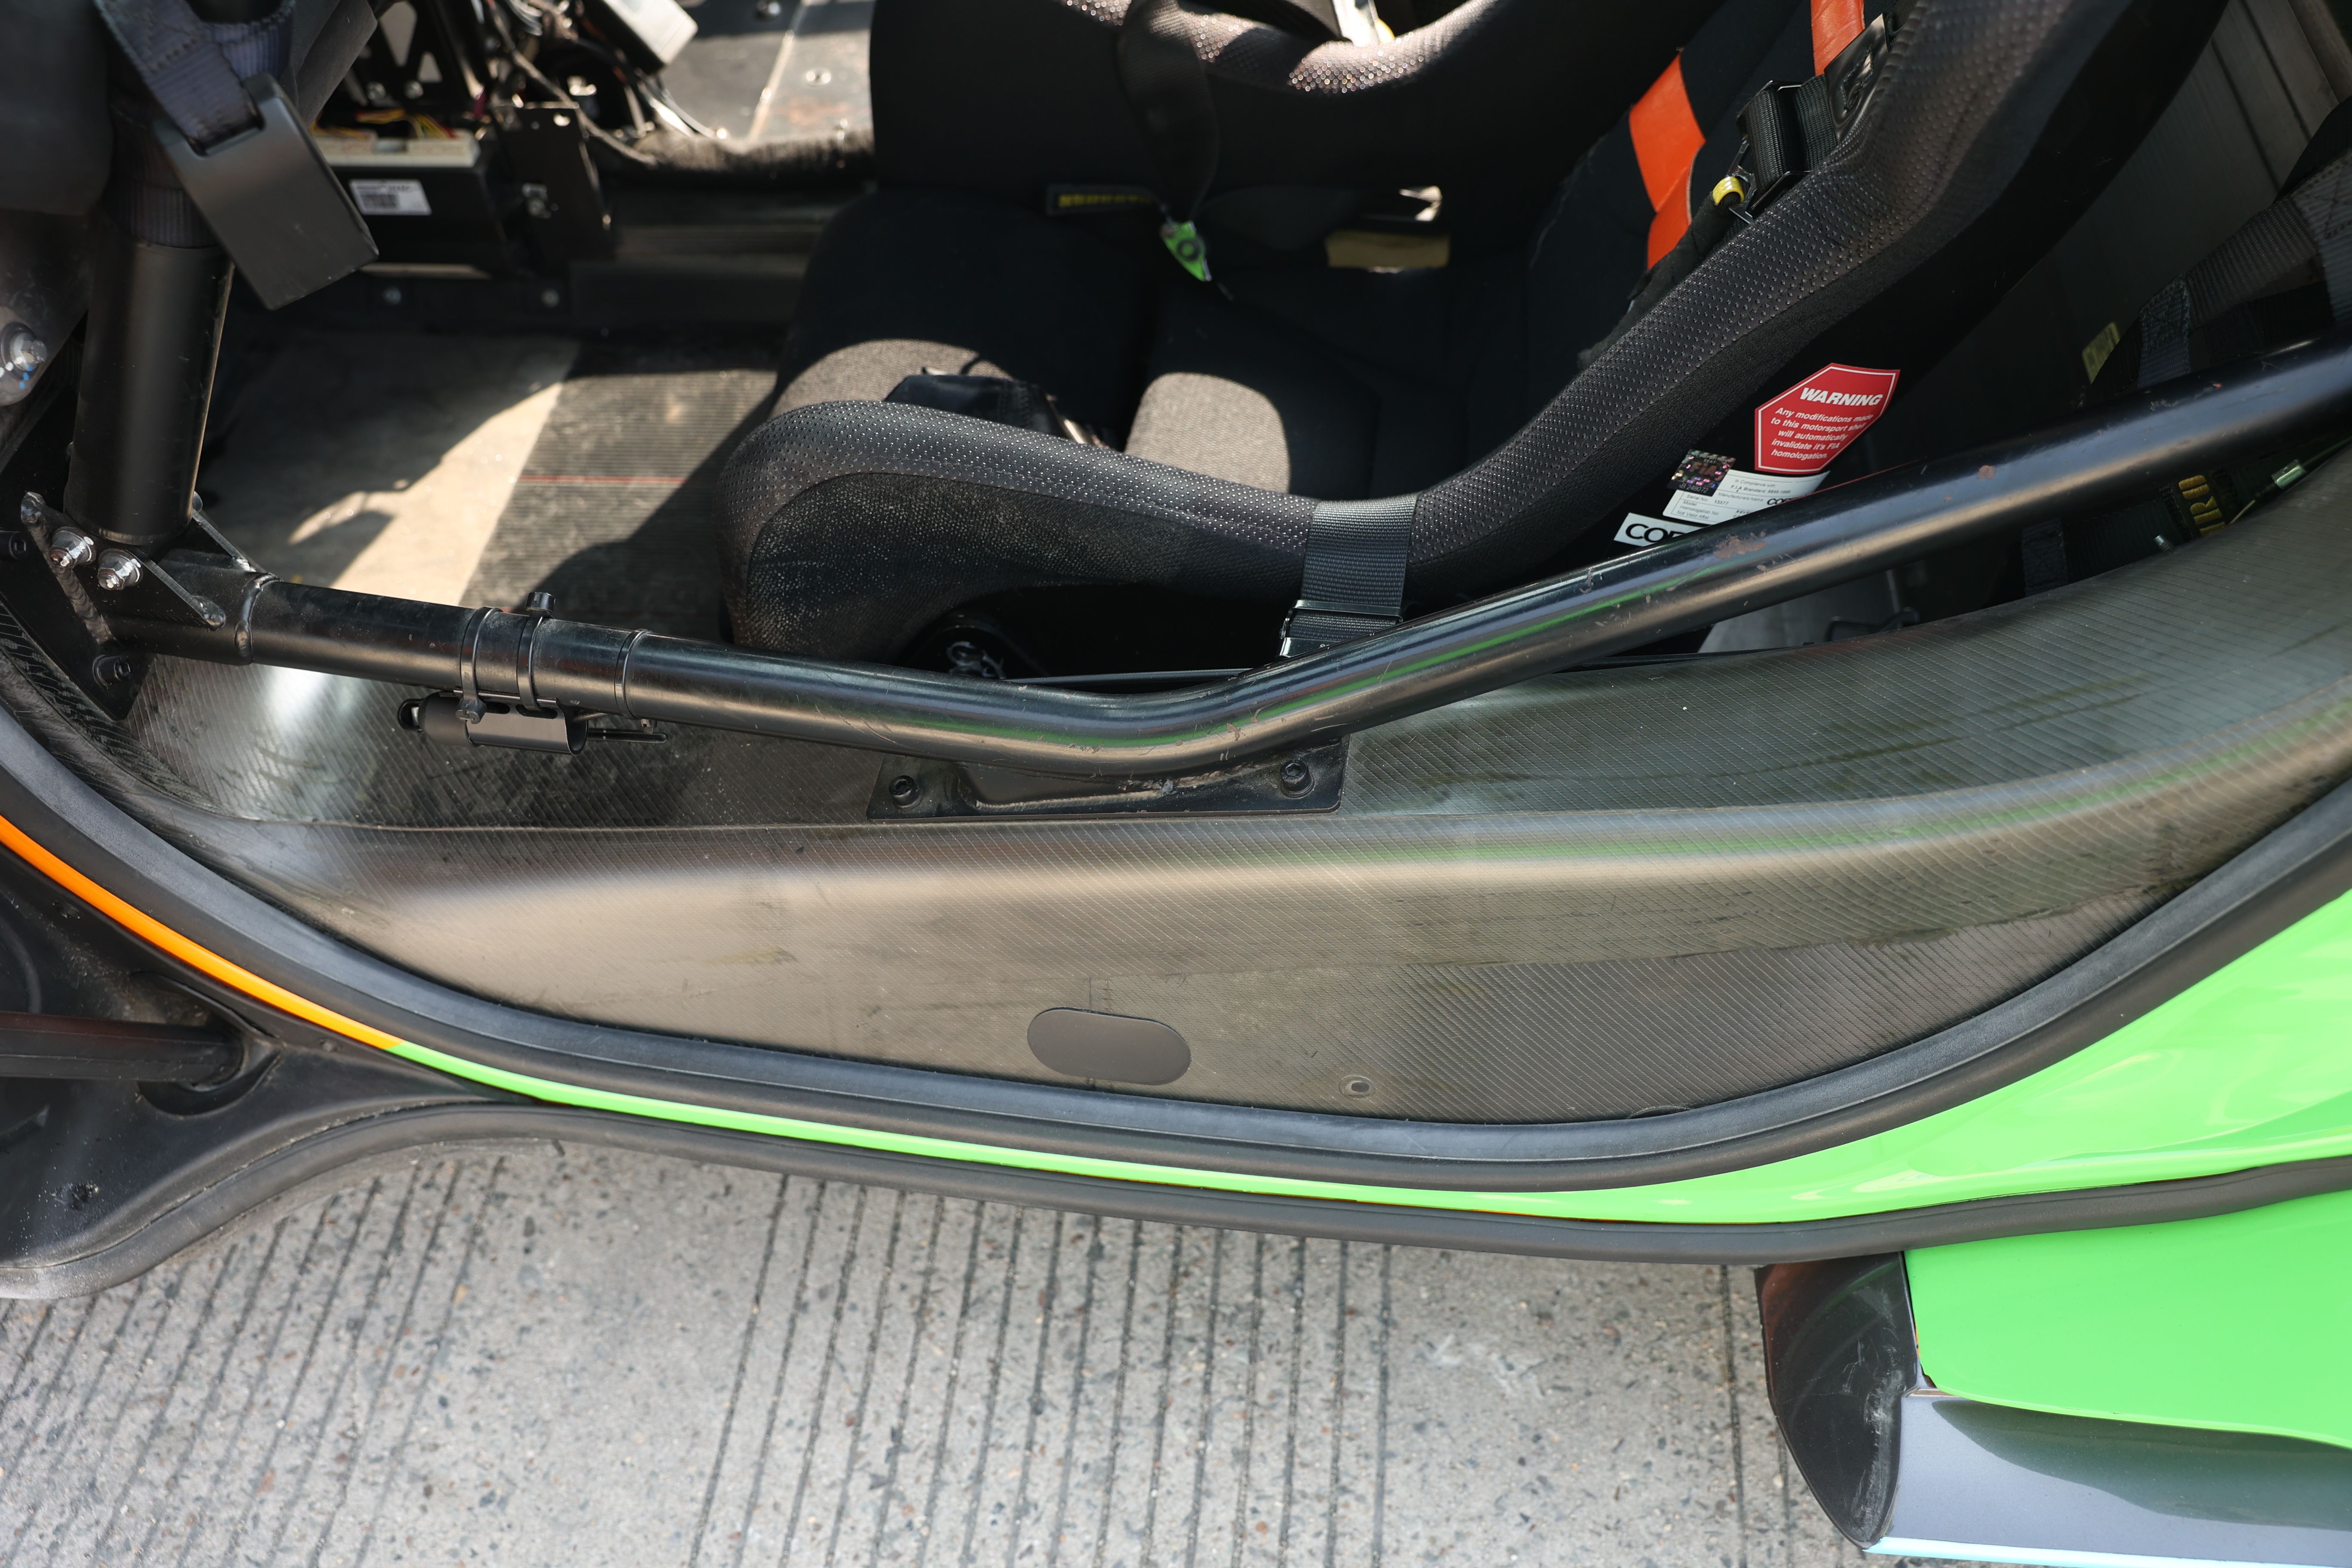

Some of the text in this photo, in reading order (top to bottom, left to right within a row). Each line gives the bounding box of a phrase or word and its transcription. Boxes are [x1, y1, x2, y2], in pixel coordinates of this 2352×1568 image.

[1800, 387, 1883, 406] WARNING
[1775, 407, 1873, 423] Any modifications made
[1771, 417, 1781, 425] to
[1782, 420, 1800, 428] this
[1801, 423, 1847, 432] motorsport
[1778, 430, 1848, 441] will automatically
[1771, 438, 1812, 450] invalidate
